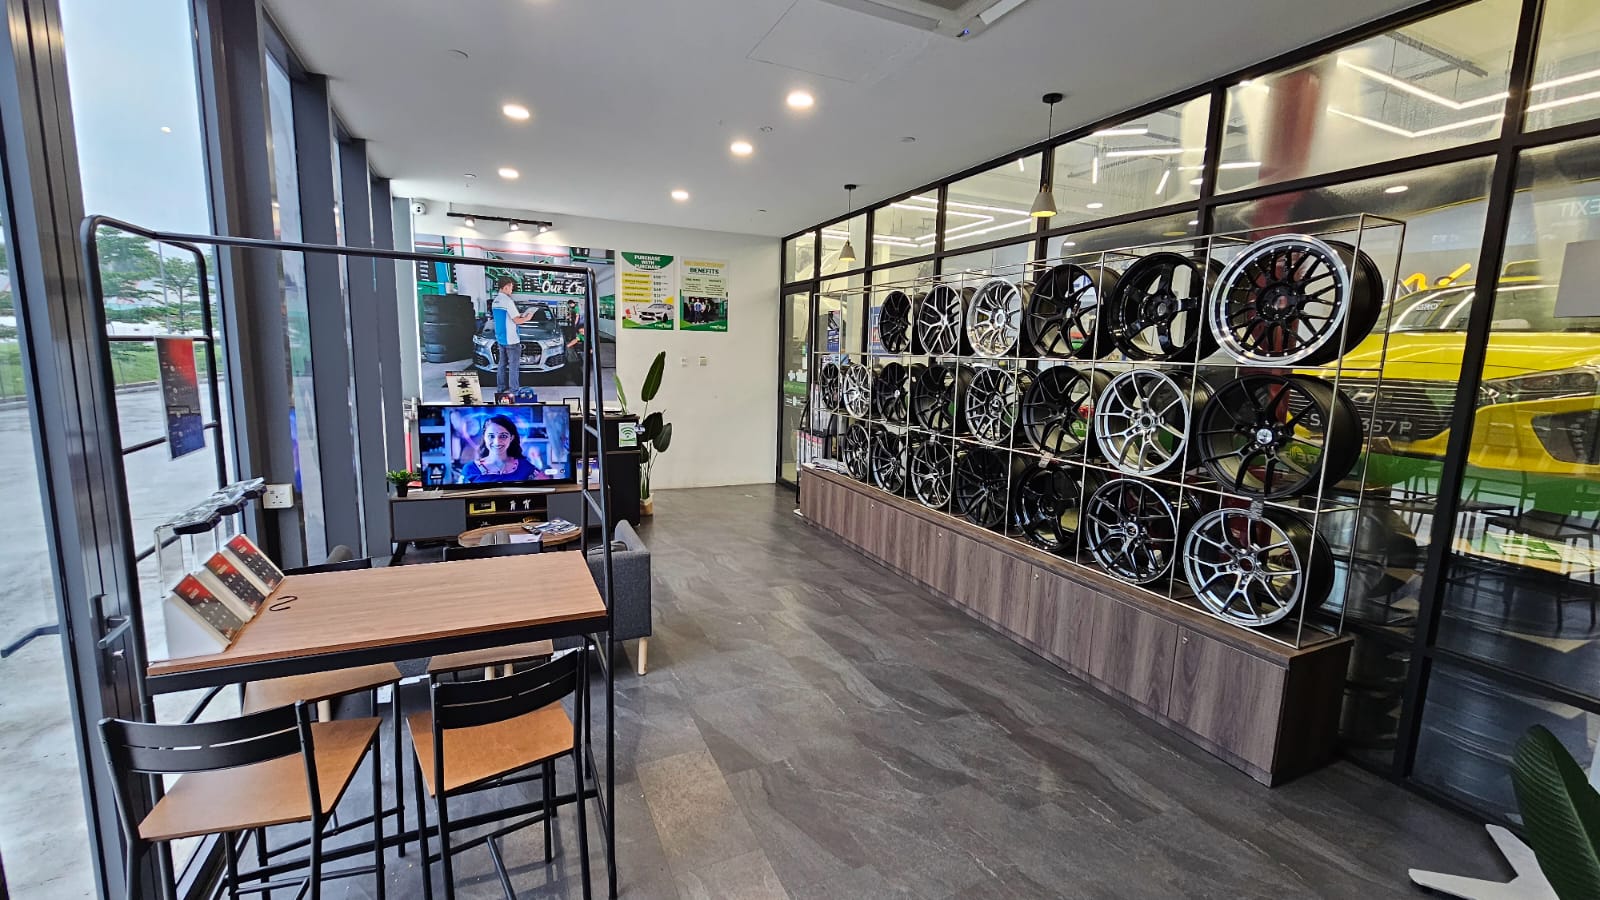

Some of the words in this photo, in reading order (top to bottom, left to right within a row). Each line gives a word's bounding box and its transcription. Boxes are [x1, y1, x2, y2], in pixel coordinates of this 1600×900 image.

[689, 267, 720, 275] BENEFITS
[542, 280, 563, 293] Our
[566, 281, 586, 295] Car
